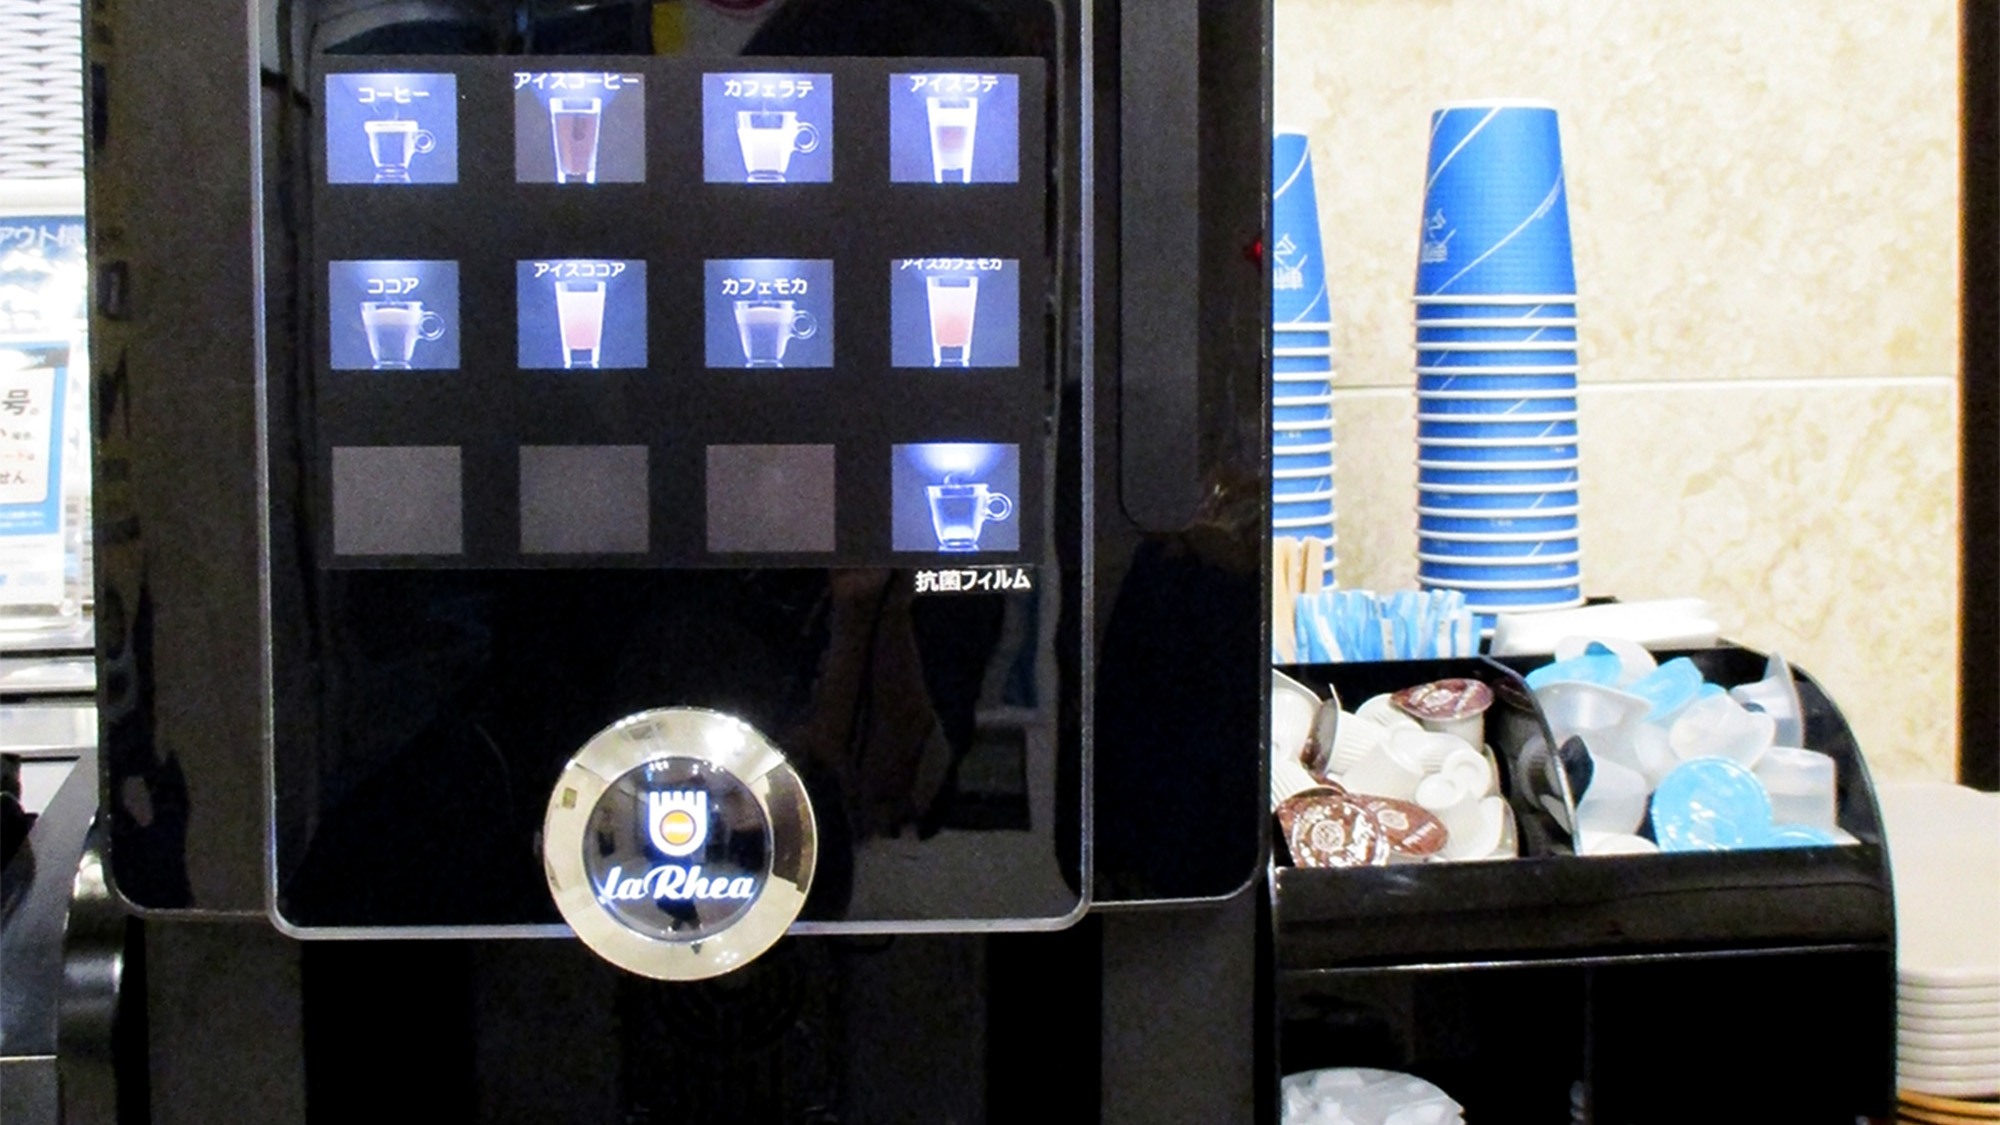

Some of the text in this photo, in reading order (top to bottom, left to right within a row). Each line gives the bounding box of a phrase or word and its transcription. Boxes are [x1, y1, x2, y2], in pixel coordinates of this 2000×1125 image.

[513, 72, 639, 90] アイスコーヒー
[724, 79, 814, 98] カフェラテ
[909, 74, 999, 92] アイスラテ
[358, 87, 429, 103] コーヒー
[534, 262, 626, 277] アイスココア
[368, 277, 419, 294] ココア
[721, 278, 808, 295] カフェモカ
[915, 569, 1032, 592] 抗菌フィルム
